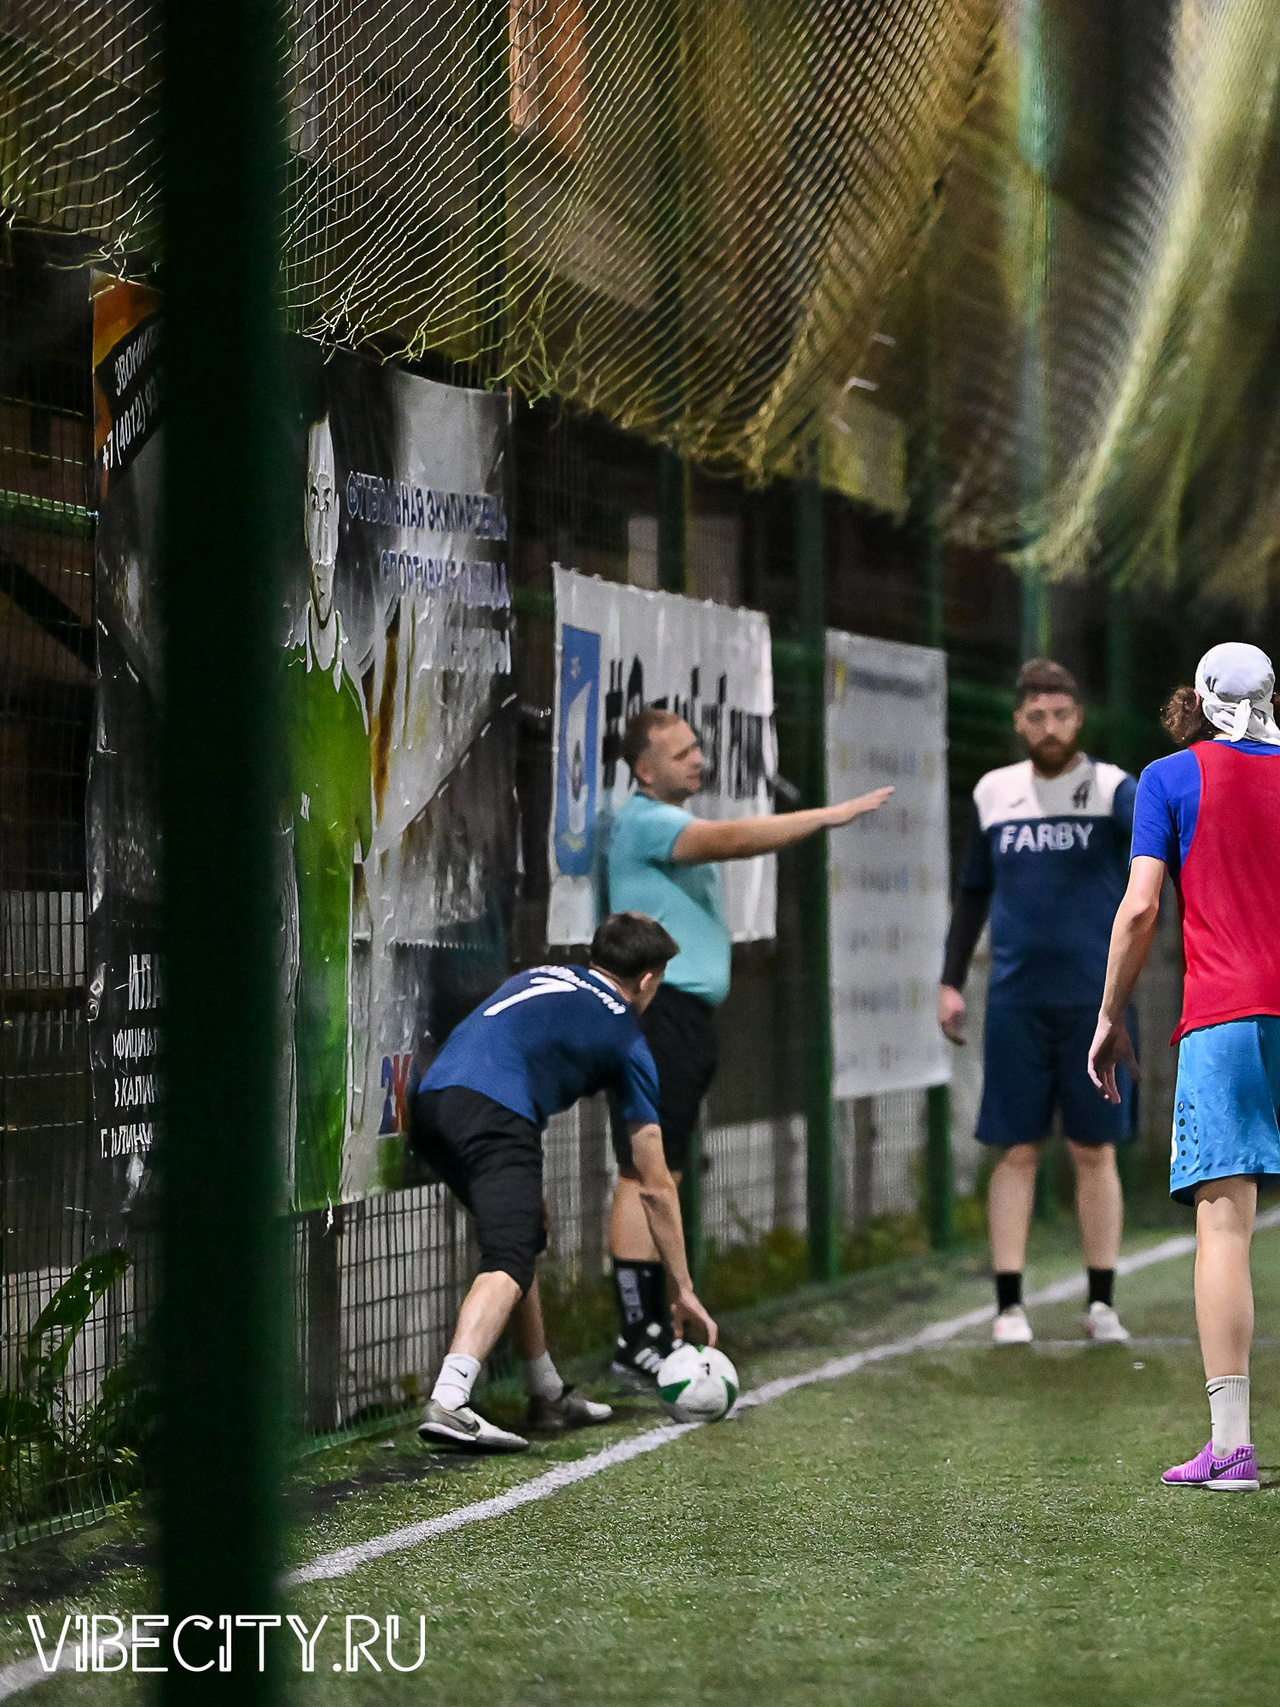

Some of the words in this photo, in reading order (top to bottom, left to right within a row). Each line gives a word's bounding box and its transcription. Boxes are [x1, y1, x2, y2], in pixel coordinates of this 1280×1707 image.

[103, 430, 114, 471] +7
[115, 390, 146, 466] (4012)
[1000, 821, 1094, 854] FARBY
[483, 976, 578, 1016] 7
[121, 1073, 159, 1107] КАЛИН
